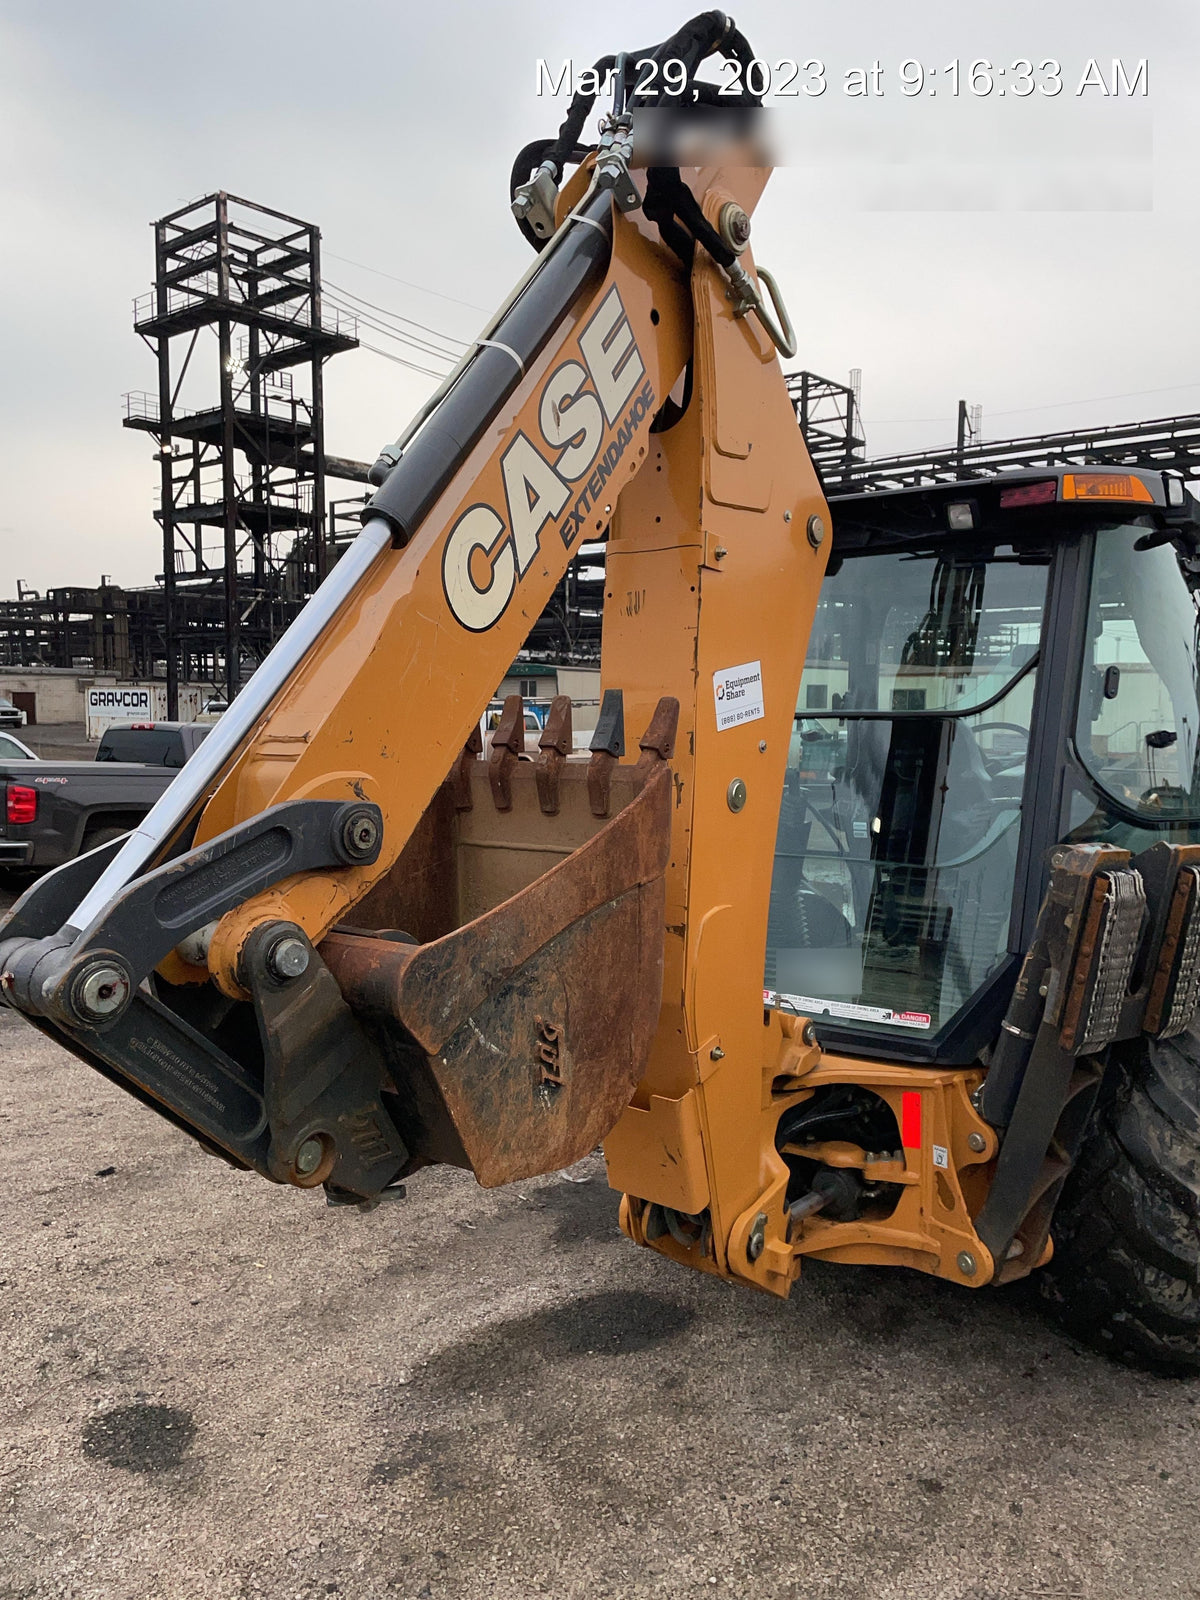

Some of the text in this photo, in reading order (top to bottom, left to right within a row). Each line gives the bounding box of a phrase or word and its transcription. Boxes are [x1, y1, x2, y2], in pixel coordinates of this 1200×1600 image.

[442, 282, 646, 633] CASE
[560, 380, 656, 550] EXTENDAHOE
[725, 674, 760, 689] Equipment
[90, 692, 148, 707] GRAYCOR
[726, 689, 745, 700] Share
[901, 1013, 927, 1022] DANGER
